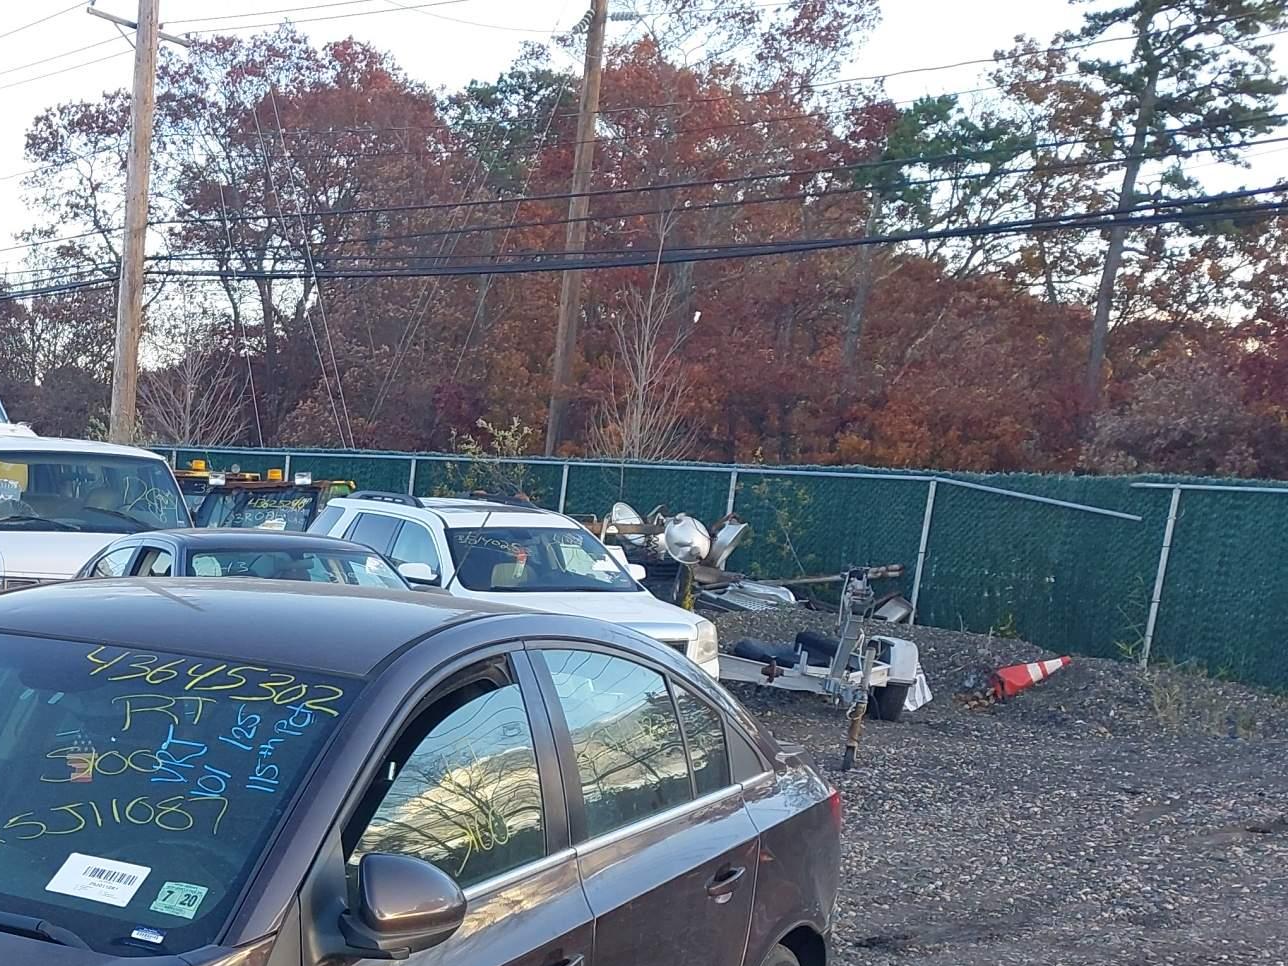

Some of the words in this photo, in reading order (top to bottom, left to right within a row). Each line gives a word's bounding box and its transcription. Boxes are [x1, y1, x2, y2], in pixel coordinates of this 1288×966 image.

[86, 646, 344, 718] 43645302
[111, 694, 217, 731] RT
[162, 890, 175, 902] 7
[179, 893, 199, 907] 20
